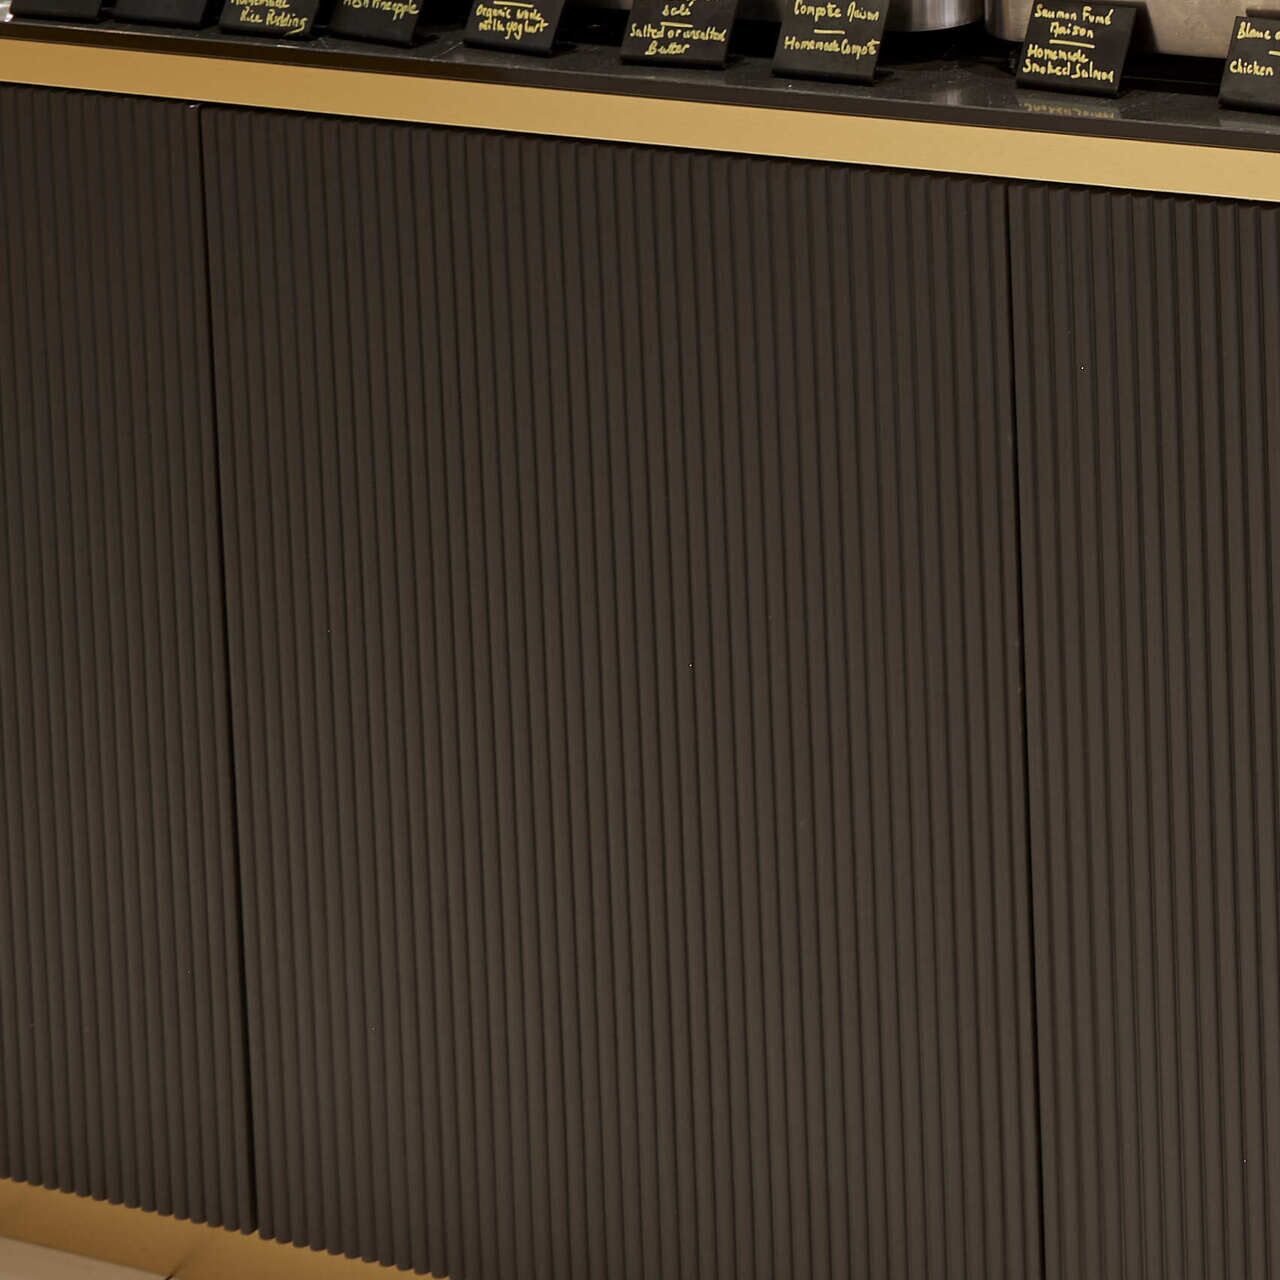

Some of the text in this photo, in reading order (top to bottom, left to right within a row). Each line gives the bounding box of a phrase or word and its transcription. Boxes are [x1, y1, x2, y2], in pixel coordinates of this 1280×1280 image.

[1034, 3, 1114, 25] Saumon Fumé
[667, 29, 682, 39] or
[1229, 58, 1274, 76] Chicken
